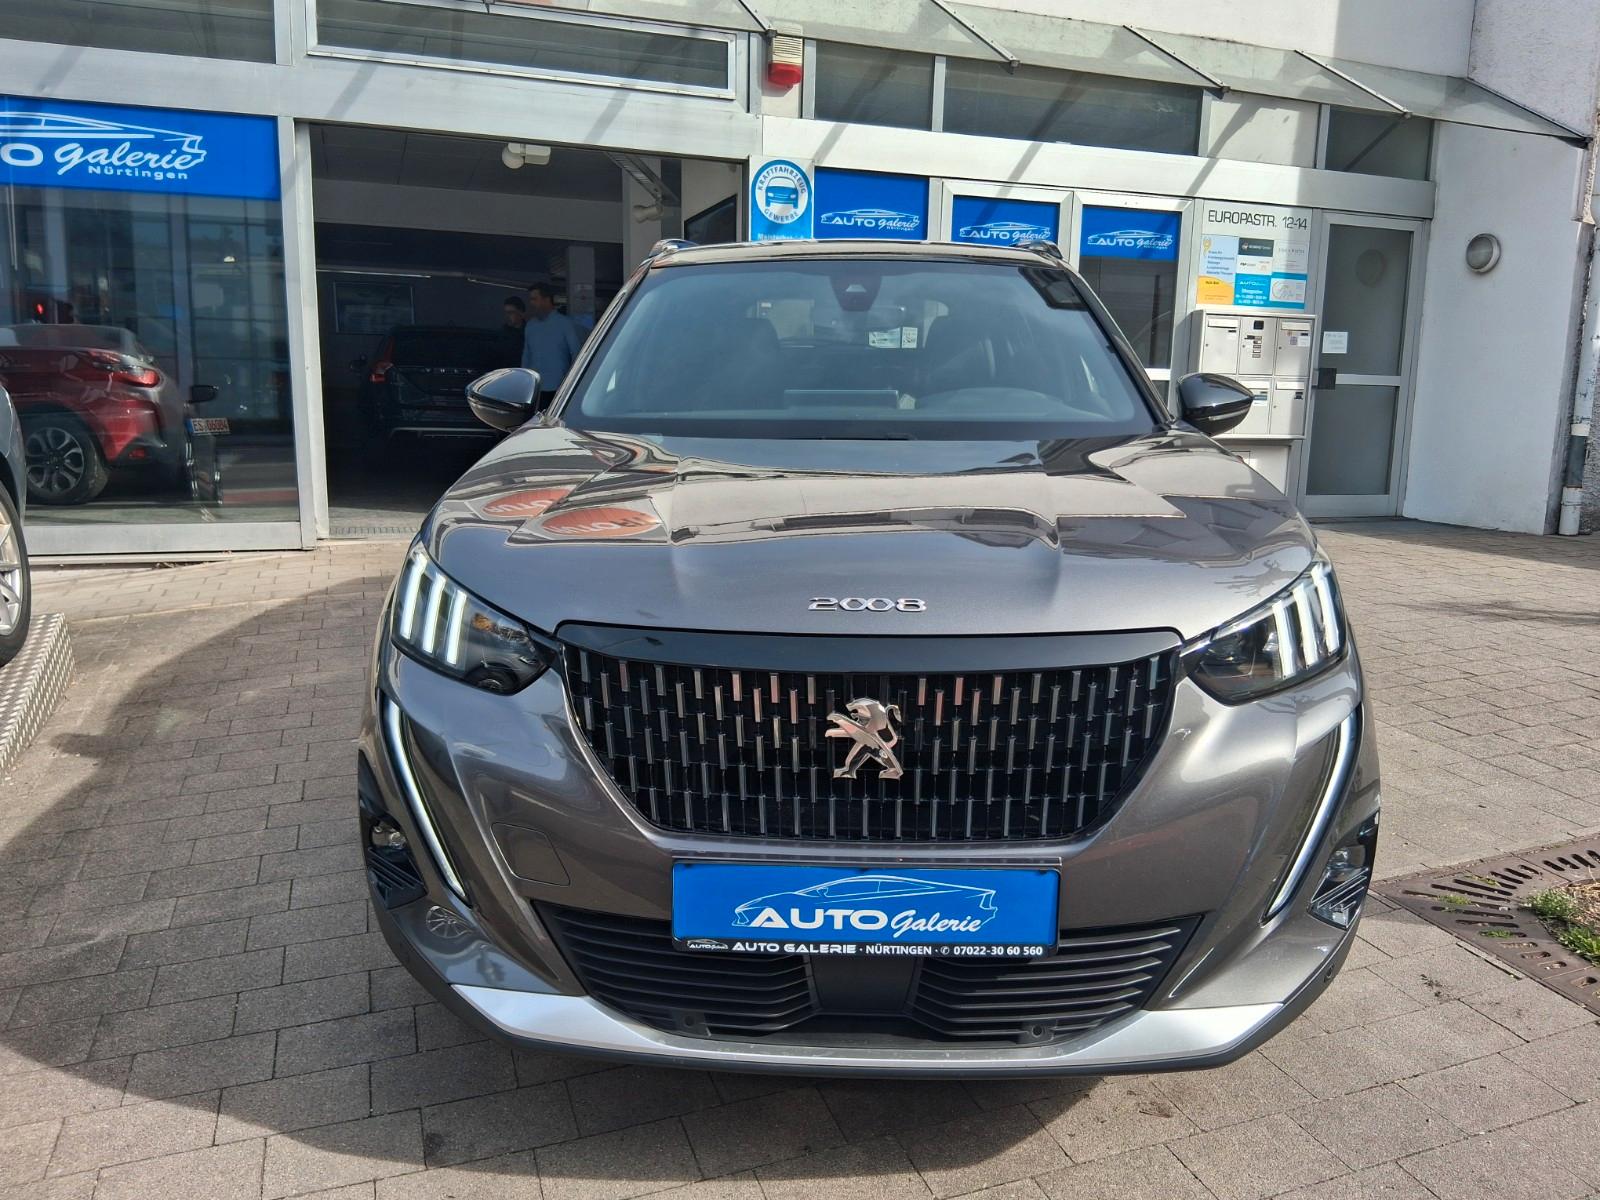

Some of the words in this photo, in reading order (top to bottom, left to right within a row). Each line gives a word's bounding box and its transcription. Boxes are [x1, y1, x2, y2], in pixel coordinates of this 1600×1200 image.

[54, 141, 197, 175] galerie
[88, 165, 188, 180] Nürtingen
[757, 166, 807, 194] KRAFTFAHRZEUG
[764, 208, 799, 222] GEWERBE
[831, 216, 876, 228] AUTO
[1207, 209, 1278, 229] EUROPASTR.
[1282, 216, 1308, 231] 12-14
[967, 230, 1010, 240] AUTO
[1096, 237, 1135, 247] AUTO
[807, 596, 928, 612] 2008
[750, 907, 889, 931] AUTO
[890, 909, 984, 938] Galerie
[733, 941, 780, 952] AUTO
[783, 942, 857, 954] GALERIE
[865, 943, 932, 955] NÜRTINGEN
[953, 946, 1004, 956] 07022-30
[1006, 946, 1021, 956] 60
[1023, 946, 1043, 956] 560
